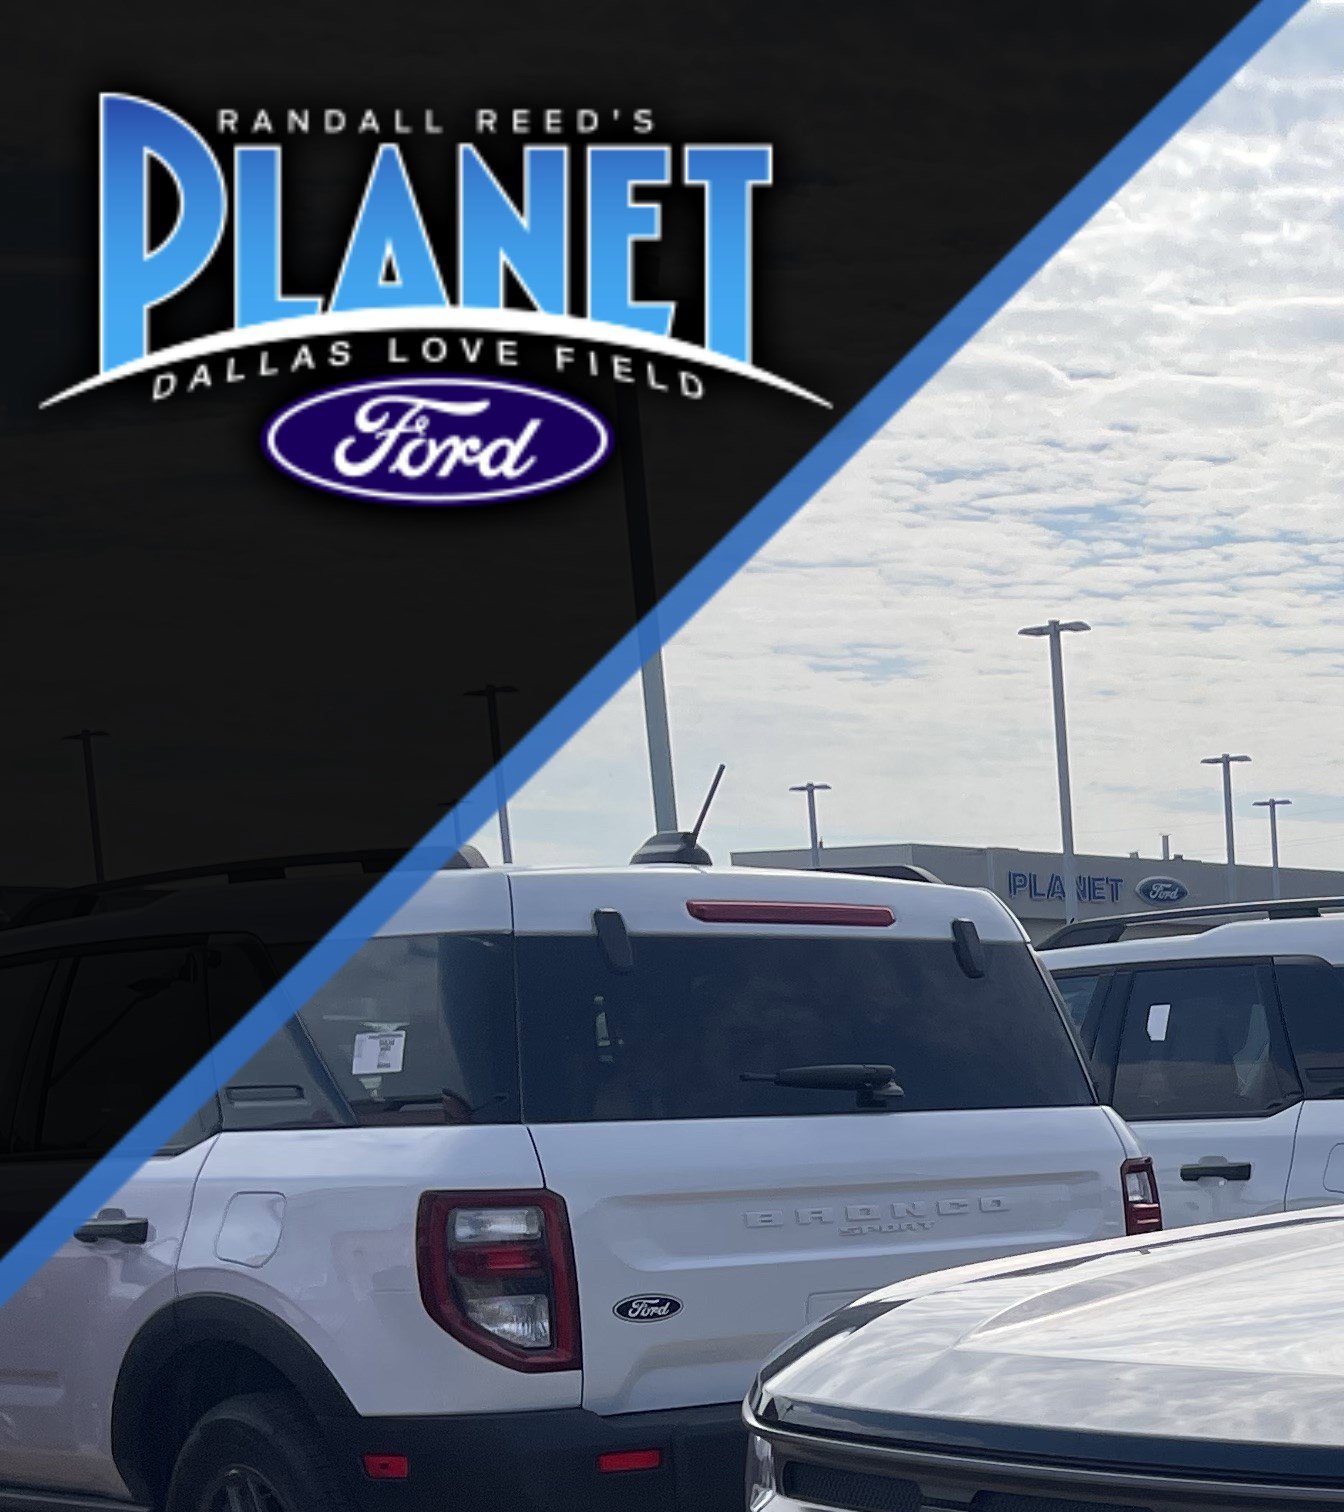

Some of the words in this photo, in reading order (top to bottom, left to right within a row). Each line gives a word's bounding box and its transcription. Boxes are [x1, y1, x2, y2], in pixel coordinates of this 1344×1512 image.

[1008, 870, 1124, 903] PLANET
[744, 1197, 1010, 1229] BRONCO
[628, 1299, 671, 1317] Ford
